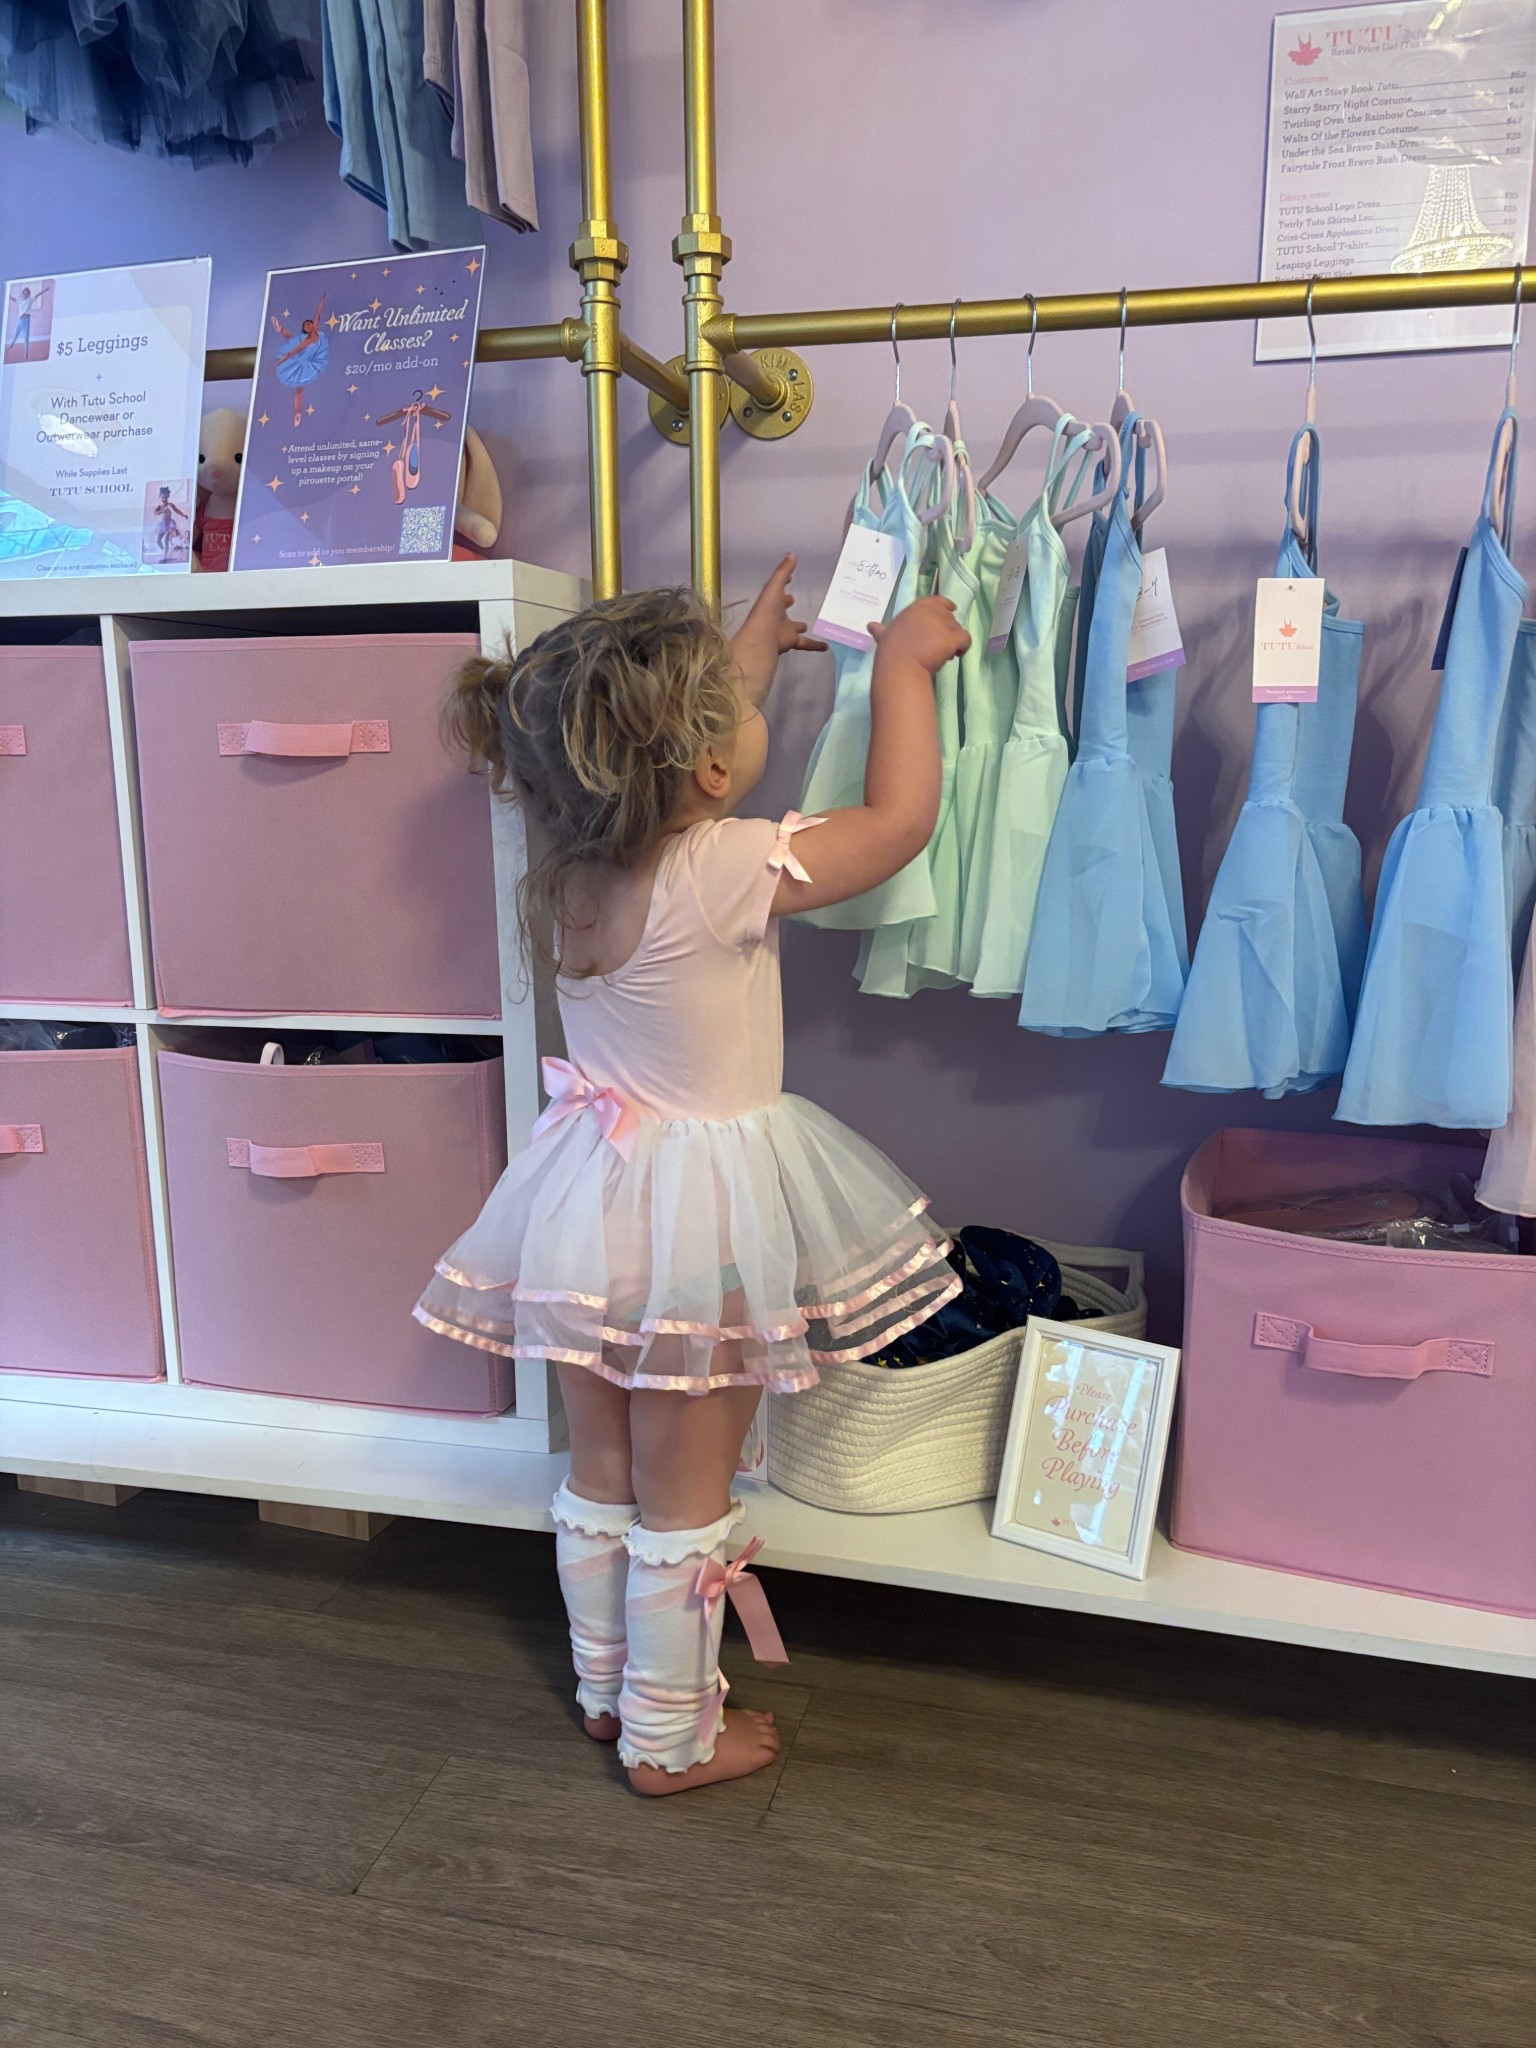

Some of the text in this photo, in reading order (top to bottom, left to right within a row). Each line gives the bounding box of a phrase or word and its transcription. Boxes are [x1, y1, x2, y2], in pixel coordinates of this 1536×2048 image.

[1326, 26, 1402, 47] TUTU
[1331, 46, 1355, 56] Retail
[1357, 45, 1379, 54] Price
[1382, 43, 1398, 52] List
[1285, 90, 1305, 100] Wall
[1308, 89, 1322, 98] Art
[1325, 87, 1349, 97] Story
[1351, 82, 1373, 94] Book
[1377, 82, 1398, 91] Tutu
[1284, 106, 1311, 115] Starry
[1313, 102, 1341, 112] Starry
[1344, 99, 1369, 110] Night
[1371, 96, 1412, 106] Costume
[1283, 119, 1321, 129] Twirling
[1348, 114, 1362, 123] the
[1365, 111, 1403, 121] Rainbow
[1283, 135, 1309, 144] Waltz
[1311, 131, 1322, 141] Of
[1325, 131, 1339, 140] the
[1341, 128, 1376, 138] Flowers
[1378, 125, 1419, 135] Costume
[1282, 148, 1309, 159] Under
[1312, 147, 1325, 155] the
[1328, 145, 1343, 154] Sea
[1346, 143, 1373, 152] Bravo
[1375, 140, 1396, 150] Bash
[1399, 139, 1424, 149] Dress
[1281, 161, 1320, 173] Fairytale
[1323, 160, 1345, 169] Frost
[1348, 157, 1373, 167] Bravo
[1376, 155, 1398, 164] Bash
[1401, 153, 1426, 163] Dress
[1279, 206, 1304, 215] TUTU
[1306, 203, 1333, 213] School
[1335, 203, 1354, 211] Logo
[1358, 201, 1380, 209] Dress
[1278, 220, 1304, 229] Twirly
[1306, 219, 1325, 227] Tutu
[1327, 215, 1356, 225] Skirted
[1277, 233, 1323, 242] Criss-Cross
[1326, 229, 1373, 239] Applesauce
[1277, 246, 1304, 256] TUTU
[1306, 243, 1336, 253] School
[1338, 241, 1368, 250] T-shirt
[1276, 257, 1354, 270] Leaping Leggings
[338, 299, 469, 332] Want Unlimited
[57, 335, 148, 356] $5 Leggings
[364, 330, 433, 355] Classes?
[345, 356, 438, 375] $20/mo add-on
[760, 353, 805, 413] KIM LAS
[51, 391, 146, 409] With Tutu School
[60, 411, 134, 425] Dancewear or
[103, 426, 153, 441] purchase
[288, 439, 383, 453] Attend unlimited, same-
[288, 451, 380, 463] level classes by signing
[56, 467, 127, 478] While Supplies Last
[291, 468, 301, 476] up
[310, 464, 341, 473] makeup
[355, 463, 374, 472] your
[298, 473, 363, 487] pirouette portal!
[50, 484, 133, 496] TUTU SCHOOL
[202, 532, 230, 542] TUT
[209, 543, 229, 552] Scho
[307, 548, 320, 556] add
[346, 544, 395, 554] membership!
[1261, 642, 1297, 650] TUTU
[1076, 1383, 1112, 1401] Please
[1045, 1395, 1137, 1436] Purchase
[1052, 1428, 1120, 1462] Before
[1041, 1457, 1120, 1500] Playing
